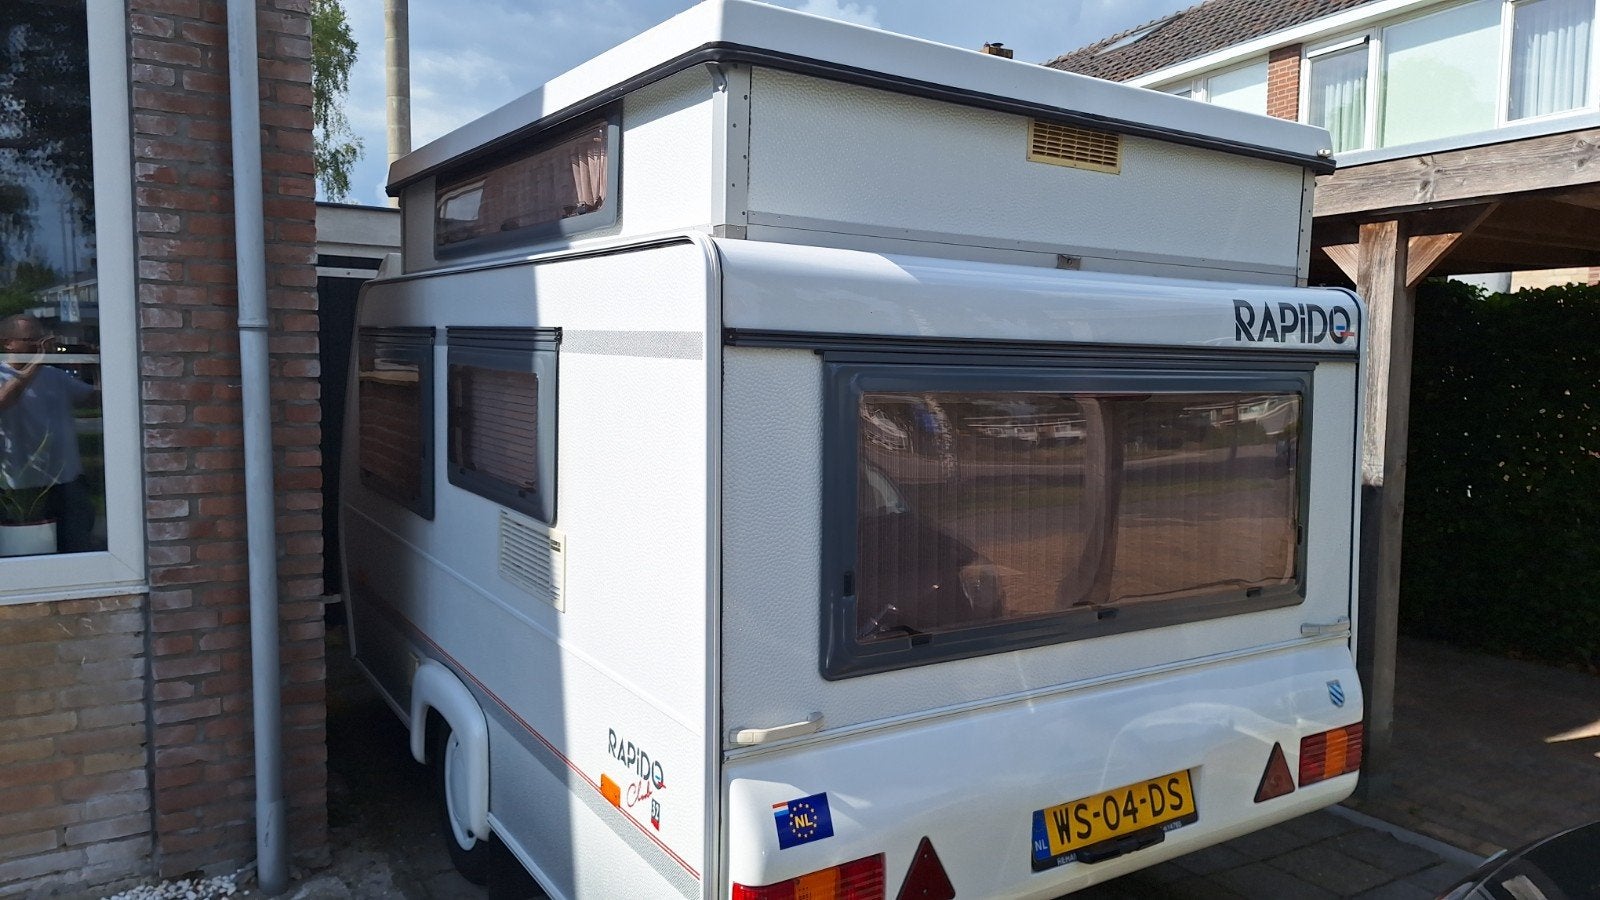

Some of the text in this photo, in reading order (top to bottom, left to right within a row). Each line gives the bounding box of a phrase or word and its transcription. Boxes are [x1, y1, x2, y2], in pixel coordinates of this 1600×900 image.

[1053, 777, 1183, 846] WS-04-DS
[794, 813, 813, 829] NL
[1034, 838, 1048, 851] NL
